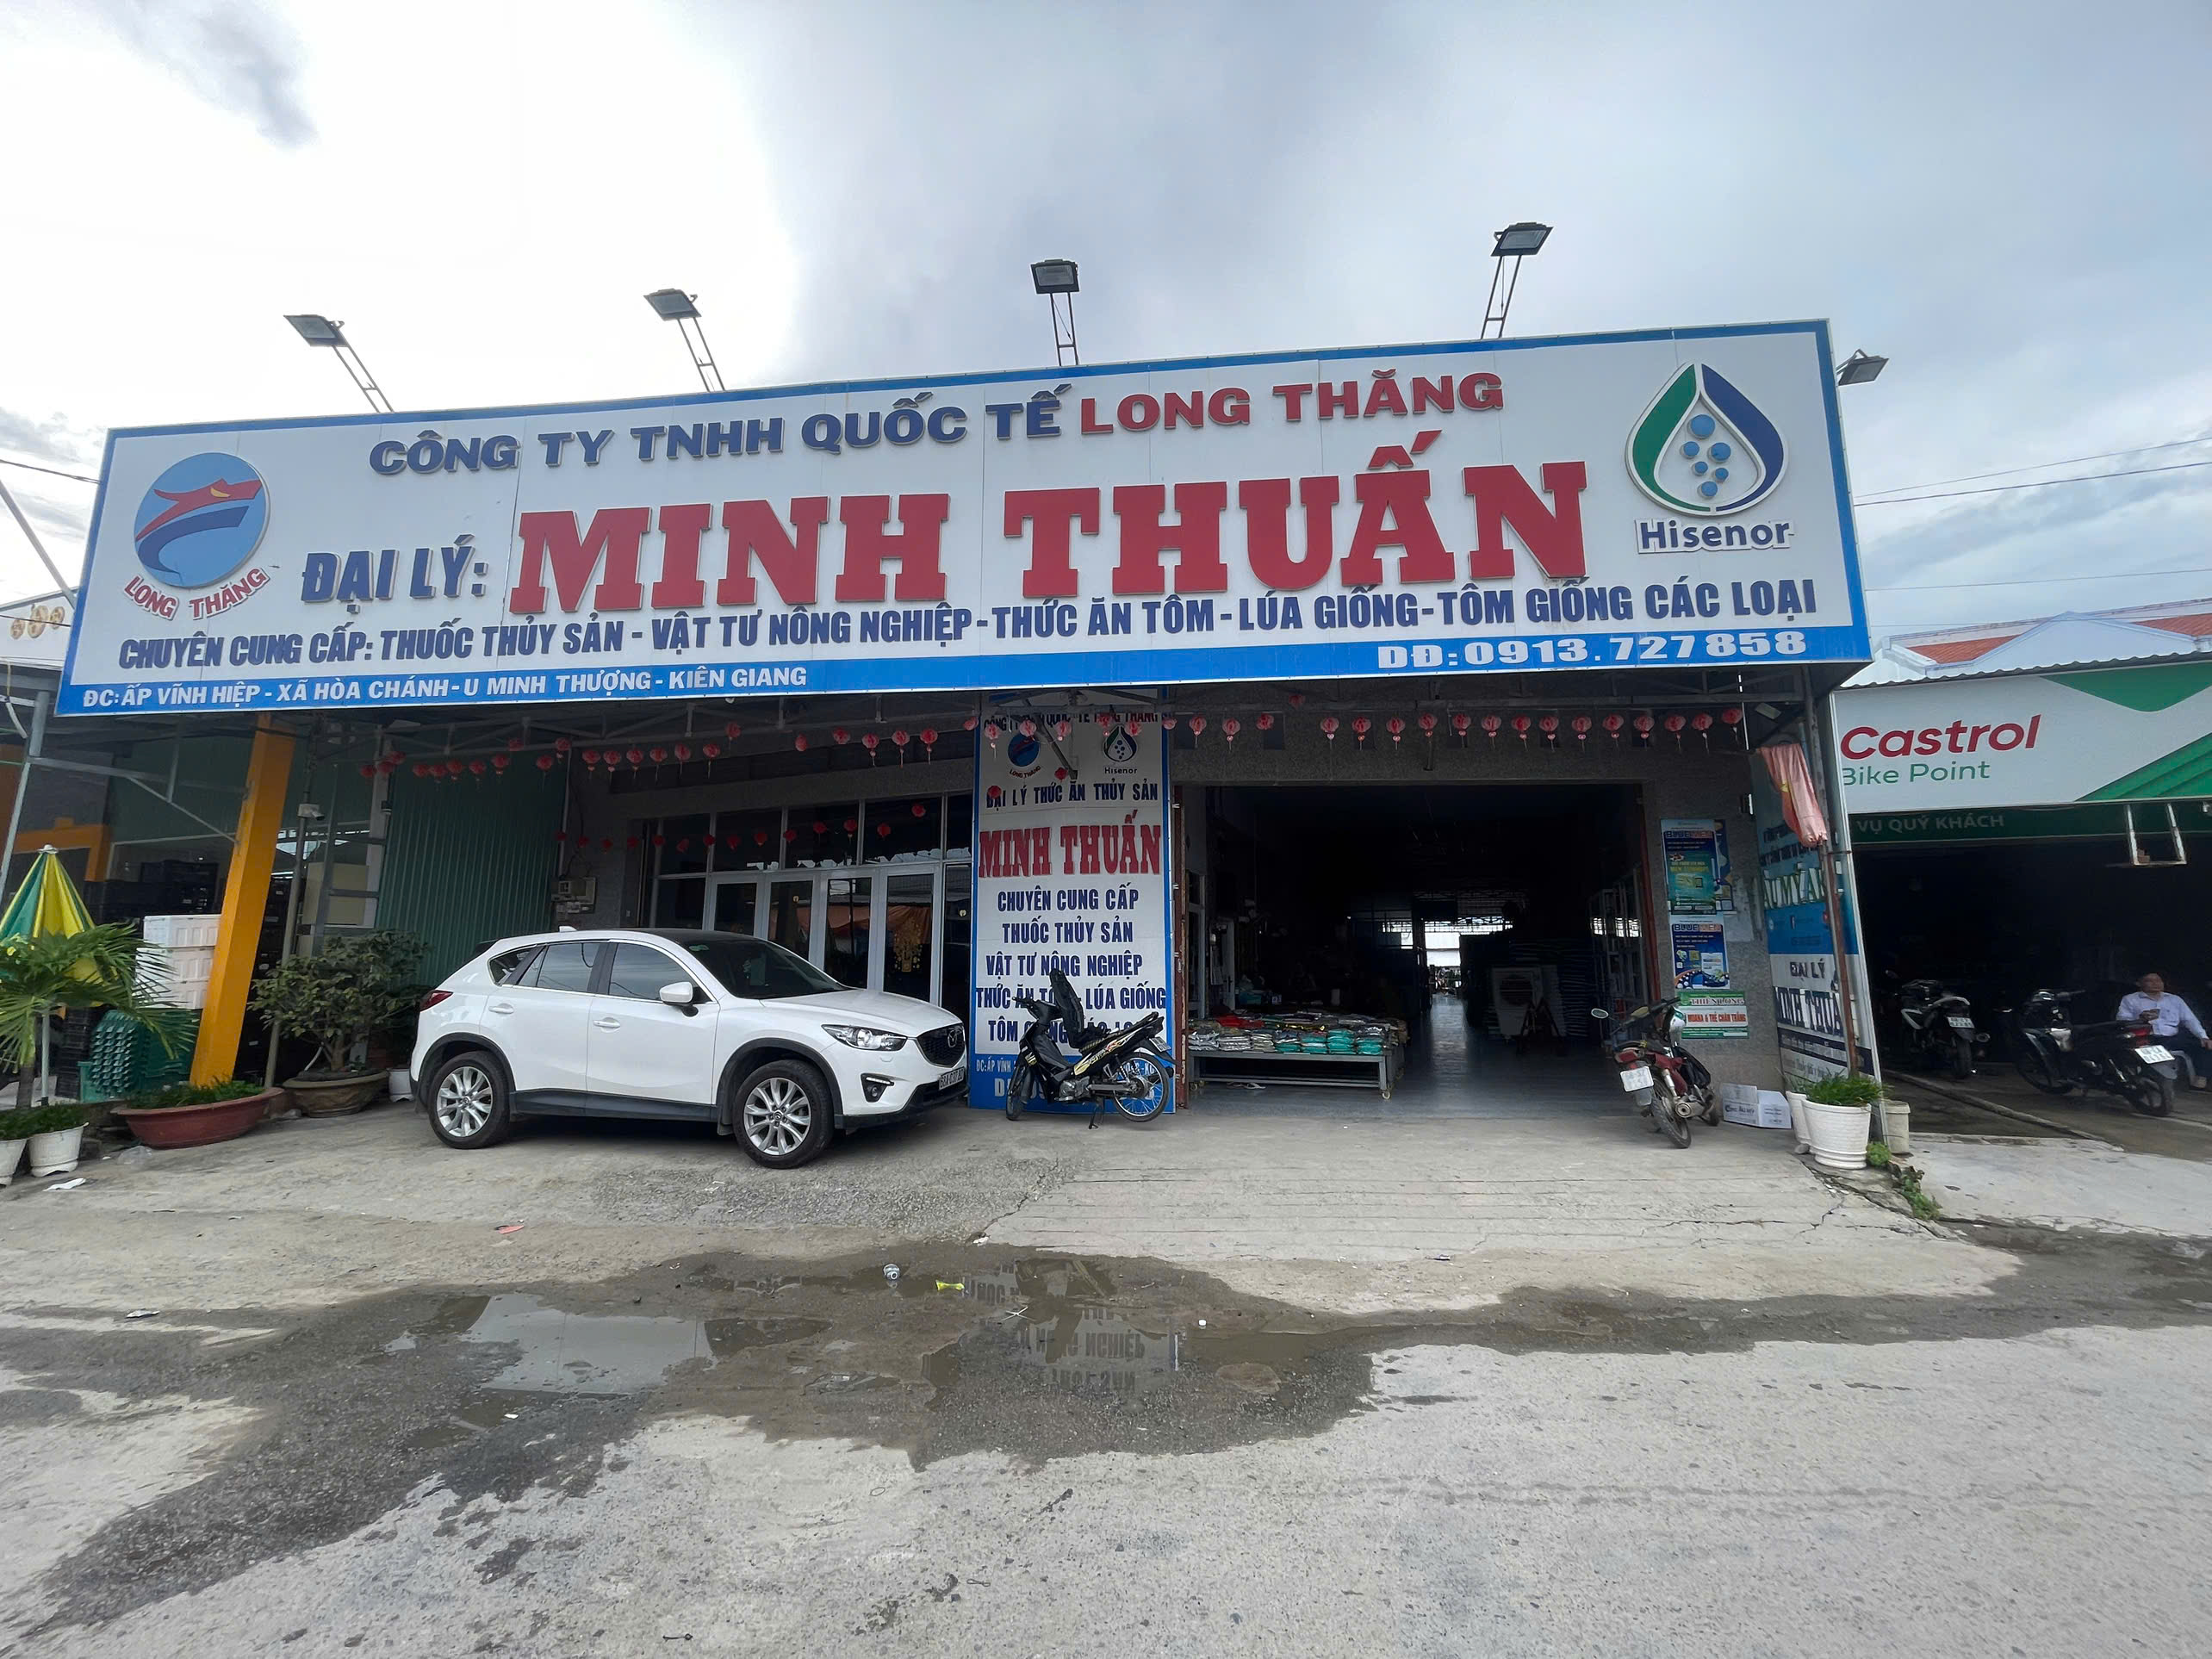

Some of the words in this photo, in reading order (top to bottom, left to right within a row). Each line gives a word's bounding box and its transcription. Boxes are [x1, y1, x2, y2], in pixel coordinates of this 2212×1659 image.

[369, 431, 519, 475] CÔNG
[537, 431, 612, 467] TY
[630, 417, 784, 462] TNHH
[801, 391, 968, 455] QUỐC
[984, 383, 1073, 440] TẾ
[1081, 386, 1251, 435] LONG
[1273, 369, 1504, 423] THĂNG
[508, 493, 949, 615] MINH
[1003, 429, 1587, 599] THUẤN
[1640, 519, 1792, 551] Hisenor
[301, 548, 400, 614] ĐẠI
[408, 533, 488, 601] LÝ:
[124, 575, 177, 620] LONG
[189, 567, 270, 620] THĂNG
[119, 630, 225, 669] CHUYÊN
[229, 634, 303, 666] CUNG
[308, 620, 373, 662] CẤP:
[381, 618, 472, 661] THUỐC
[481, 613, 556, 656] THỦY
[562, 612, 624, 654] SẢN
[652, 610, 712, 655] VẬT
[718, 608, 761, 647] TƯ
[768, 606, 851, 645] NÔNG
[1087, 599, 1133, 636] ĂN
[1526, 575, 1633, 624] GIỐNG
[1644, 575, 1720, 619] CÁC
[1730, 578, 1817, 622] LOẠI
[158, 682, 207, 705] VĨNH
[211, 680, 261, 709] HIỆP
[276, 678, 308, 702] XÃ
[313, 677, 361, 702] HÒA
[487, 675, 546, 697] MINH
[556, 668, 652, 696] THƯỢNG
[668, 665, 725, 690] KIÊN
[731, 667, 808, 688] GIANG
[1840, 713, 2042, 761] Castrol
[1842, 765, 1900, 786] Bike
[1909, 760, 1991, 783] Point
[1012, 785, 1028, 806] LÝ
[1034, 782, 1062, 804] THỨC
[1069, 779, 1086, 801] ĂN
[1093, 778, 1126, 801] THỦY
[1133, 778, 1159, 801] SẢN
[1856, 818, 1883, 835] VỤ
[1887, 814, 1931, 834] QUÝ
[1935, 812, 2006, 830] KHÁCH
[979, 826, 1052, 879] MINH
[1060, 809, 1161, 877] THUẤN
[997, 885, 1052, 912] CHUYÊN
[1056, 888, 1100, 910] CUNG
[1104, 881, 1139, 910] CẤP
[1002, 916, 1050, 944] THUỐC
[1054, 916, 1095, 944] THỦY
[1100, 916, 1134, 943] SẢN
[985, 951, 1012, 979] VẬT
[1017, 952, 1037, 976] TƯ
[1041, 950, 1080, 977] NÔNG
[1087, 949, 1143, 979] NGHIỆP
[975, 982, 1010, 1009] THỨC
[1085, 983, 1115, 1010] LÚA
[1120, 980, 1166, 1010] GIỐNG
[988, 1016, 1018, 1042] TÔM
